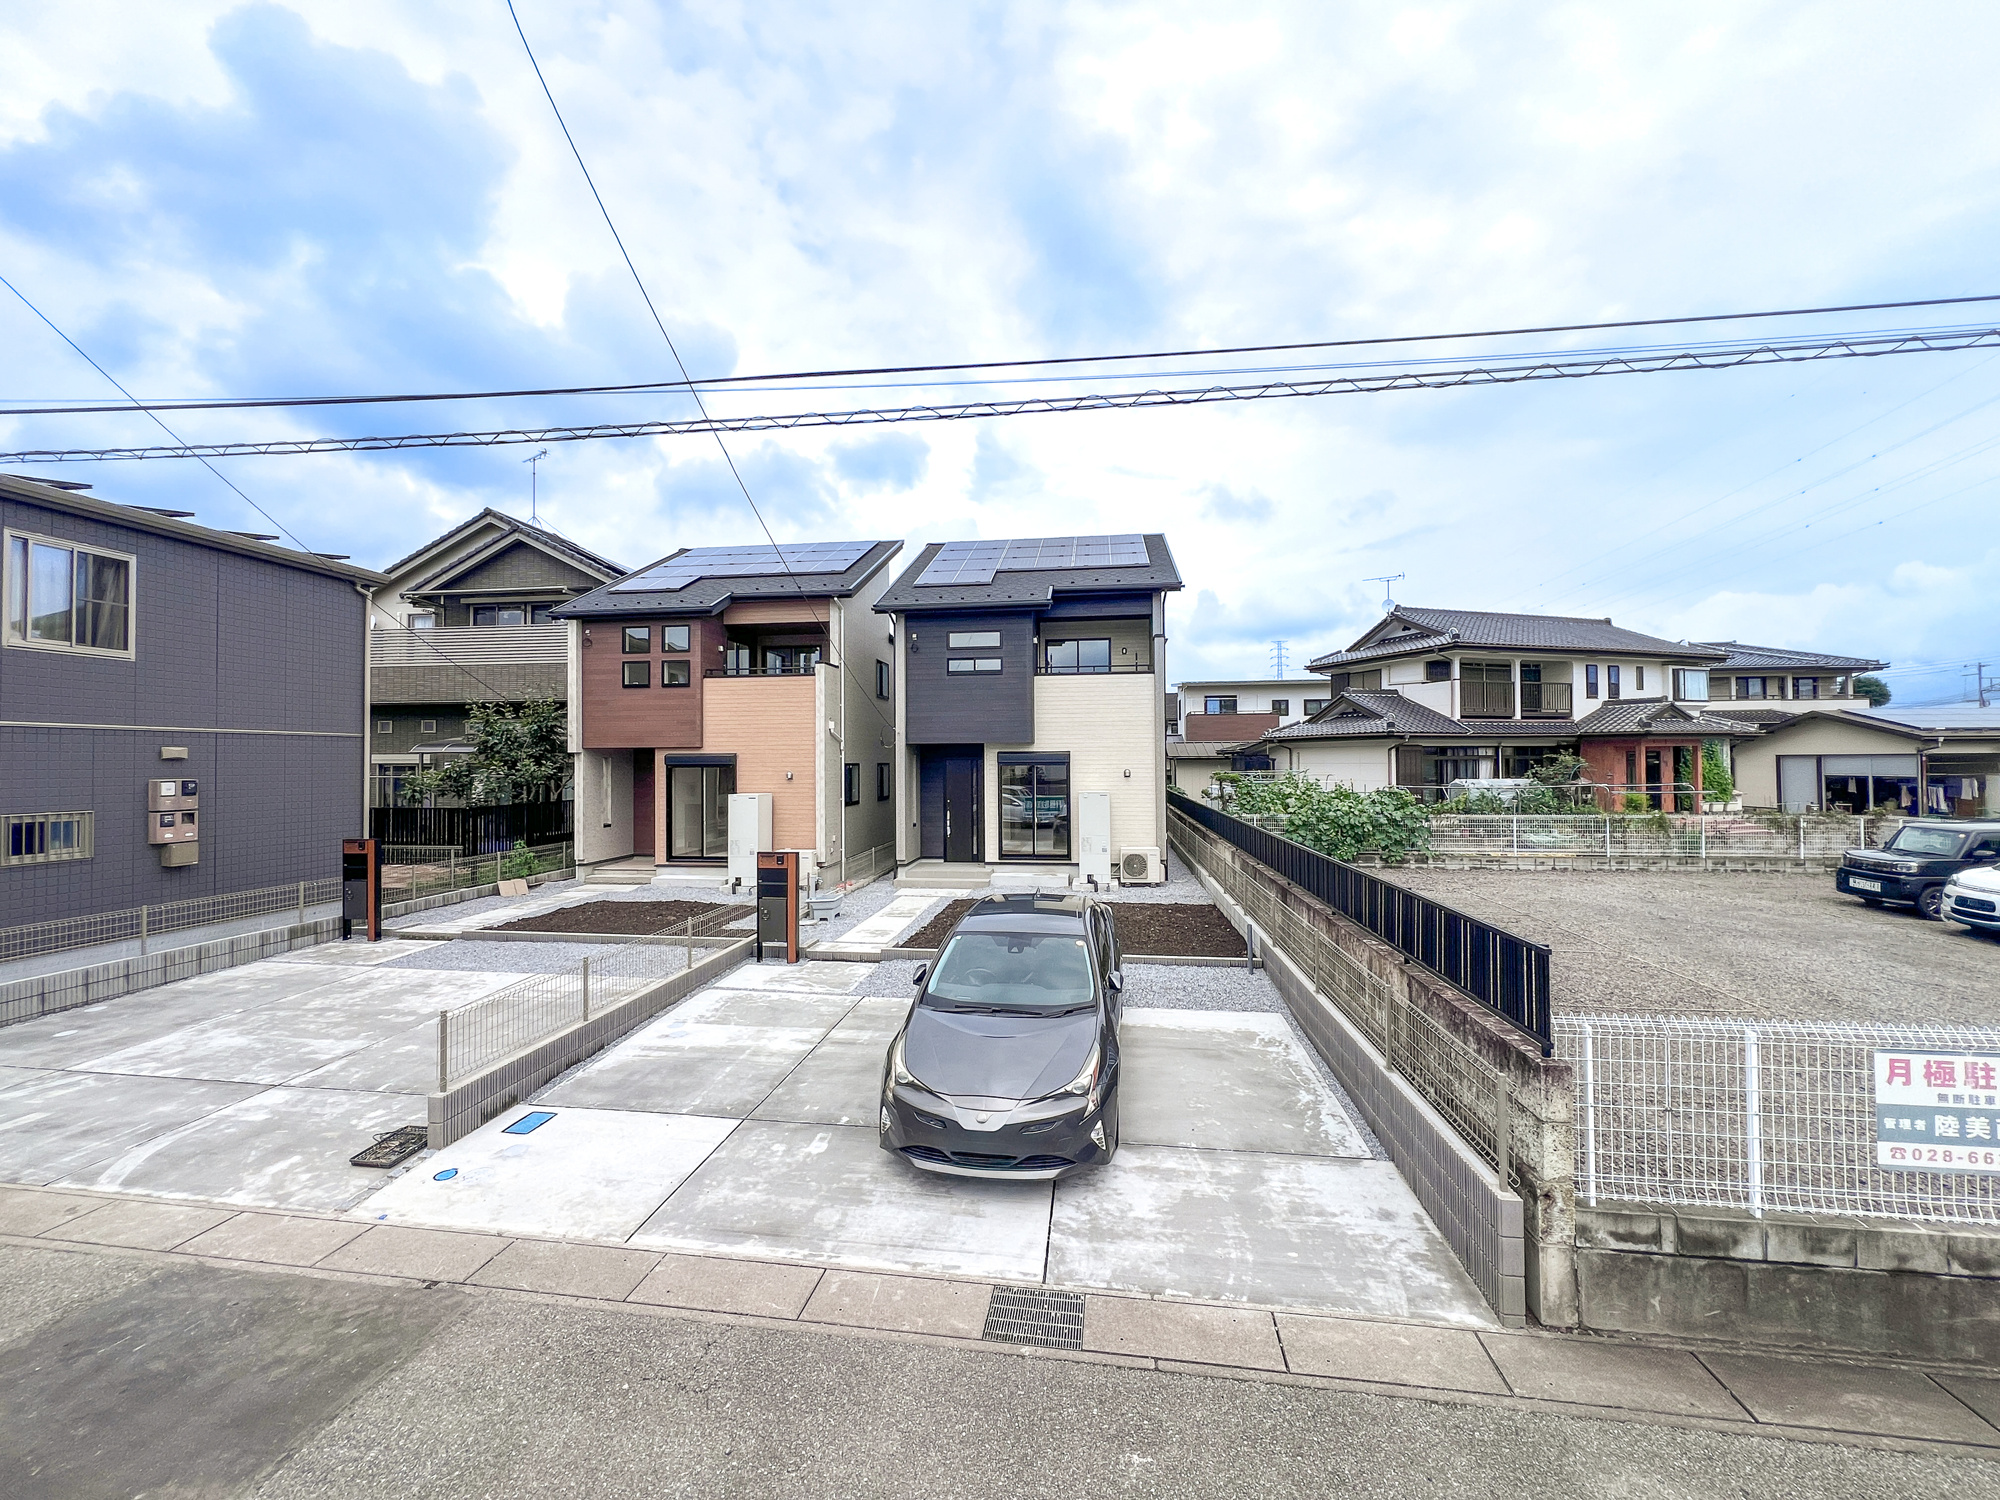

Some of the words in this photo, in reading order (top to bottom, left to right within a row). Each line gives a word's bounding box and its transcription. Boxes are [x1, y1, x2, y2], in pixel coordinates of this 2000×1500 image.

[1886, 1058, 1998, 1090] 月極駐
[1934, 1114, 2000, 1140] 陸美
[1911, 1148, 2000, 1165] 028-66
